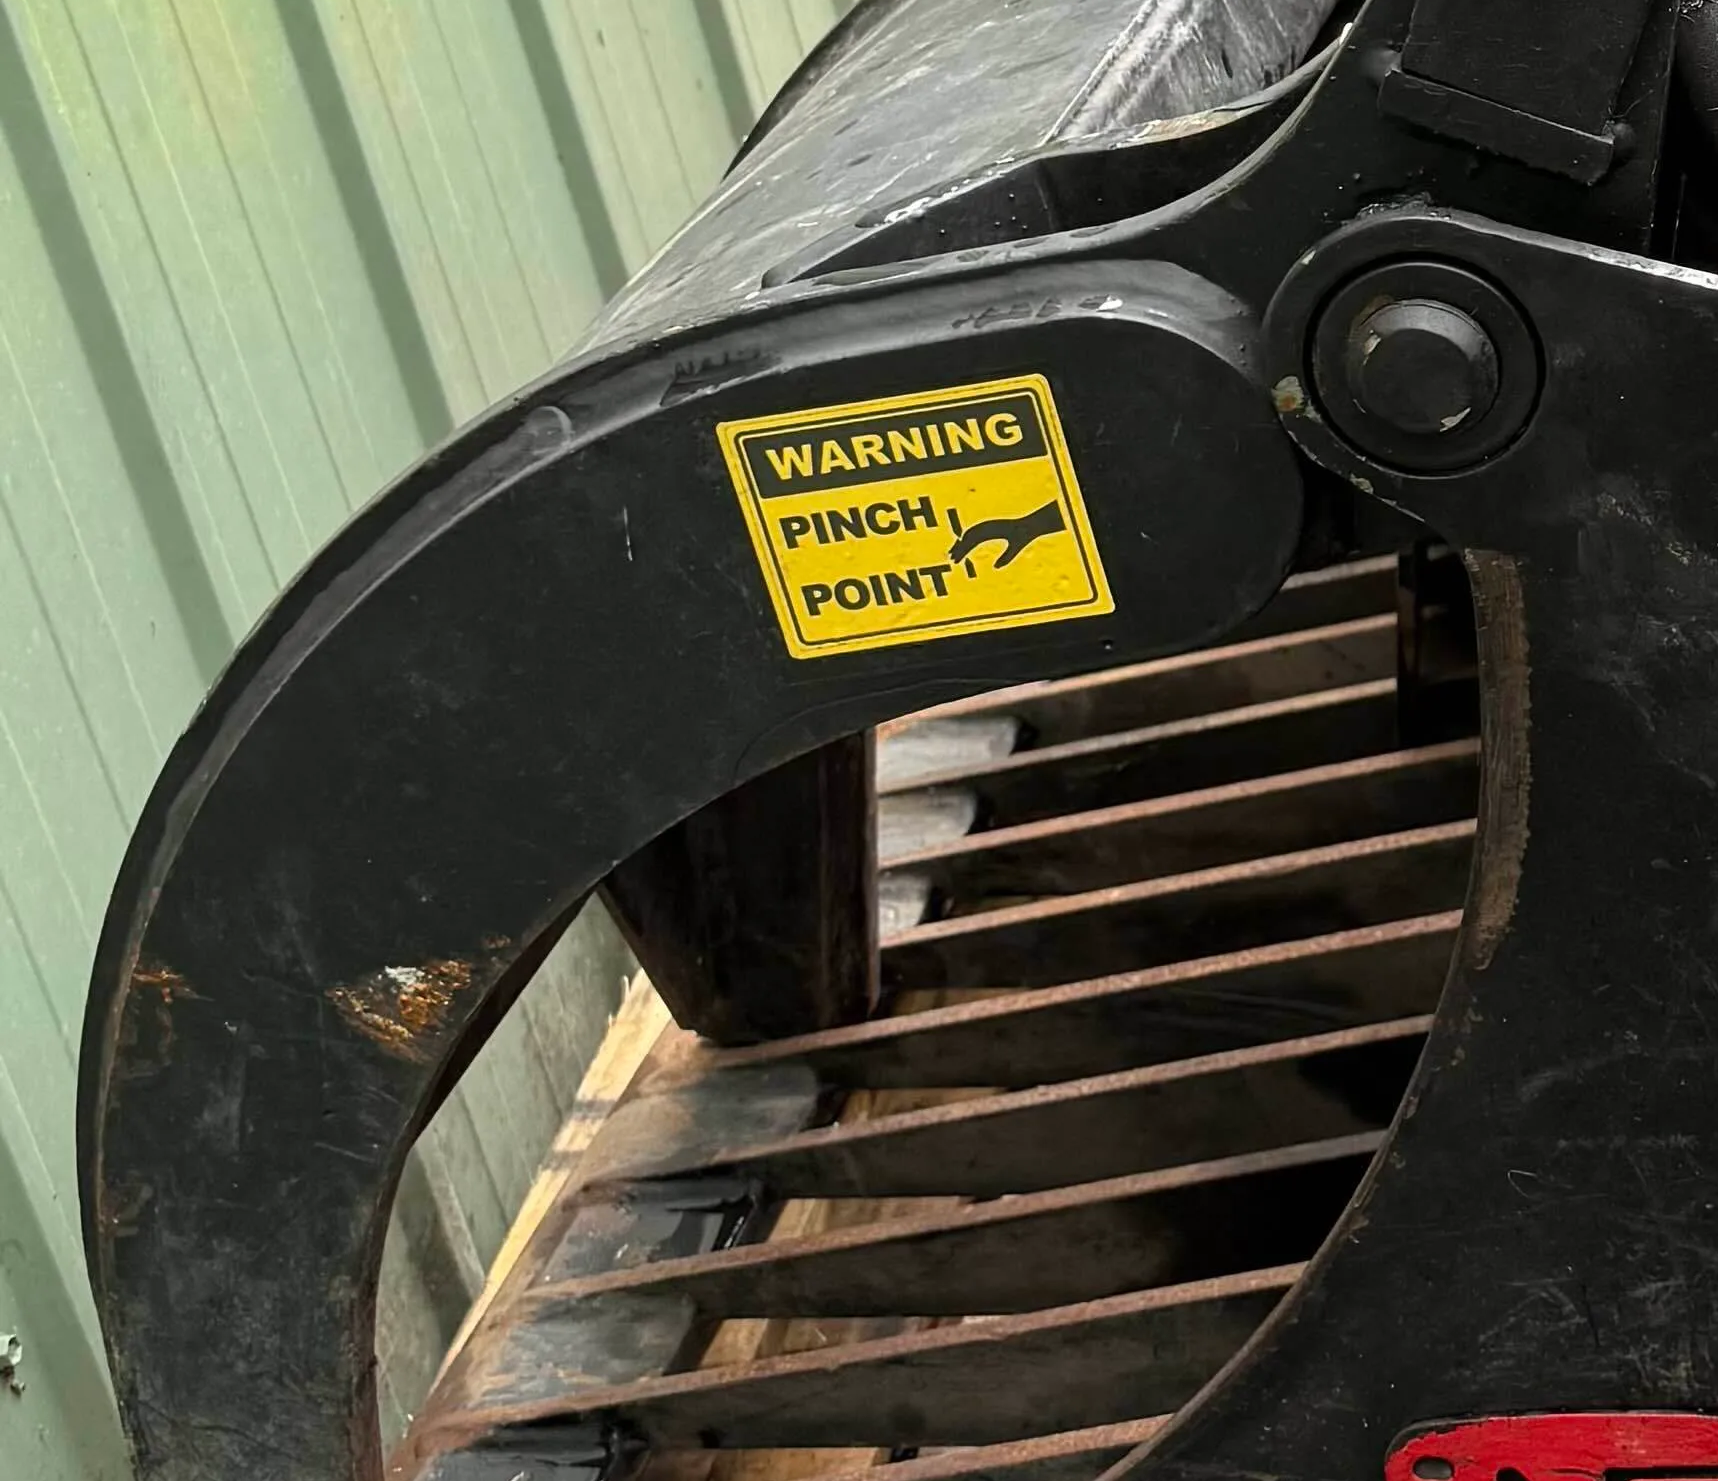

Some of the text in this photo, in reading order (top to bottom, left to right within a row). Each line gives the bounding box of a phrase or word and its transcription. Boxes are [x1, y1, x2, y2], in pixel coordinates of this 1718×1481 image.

[765, 413, 1023, 481] WARNING
[779, 496, 938, 549] PINCH
[801, 564, 951, 616] POINT
